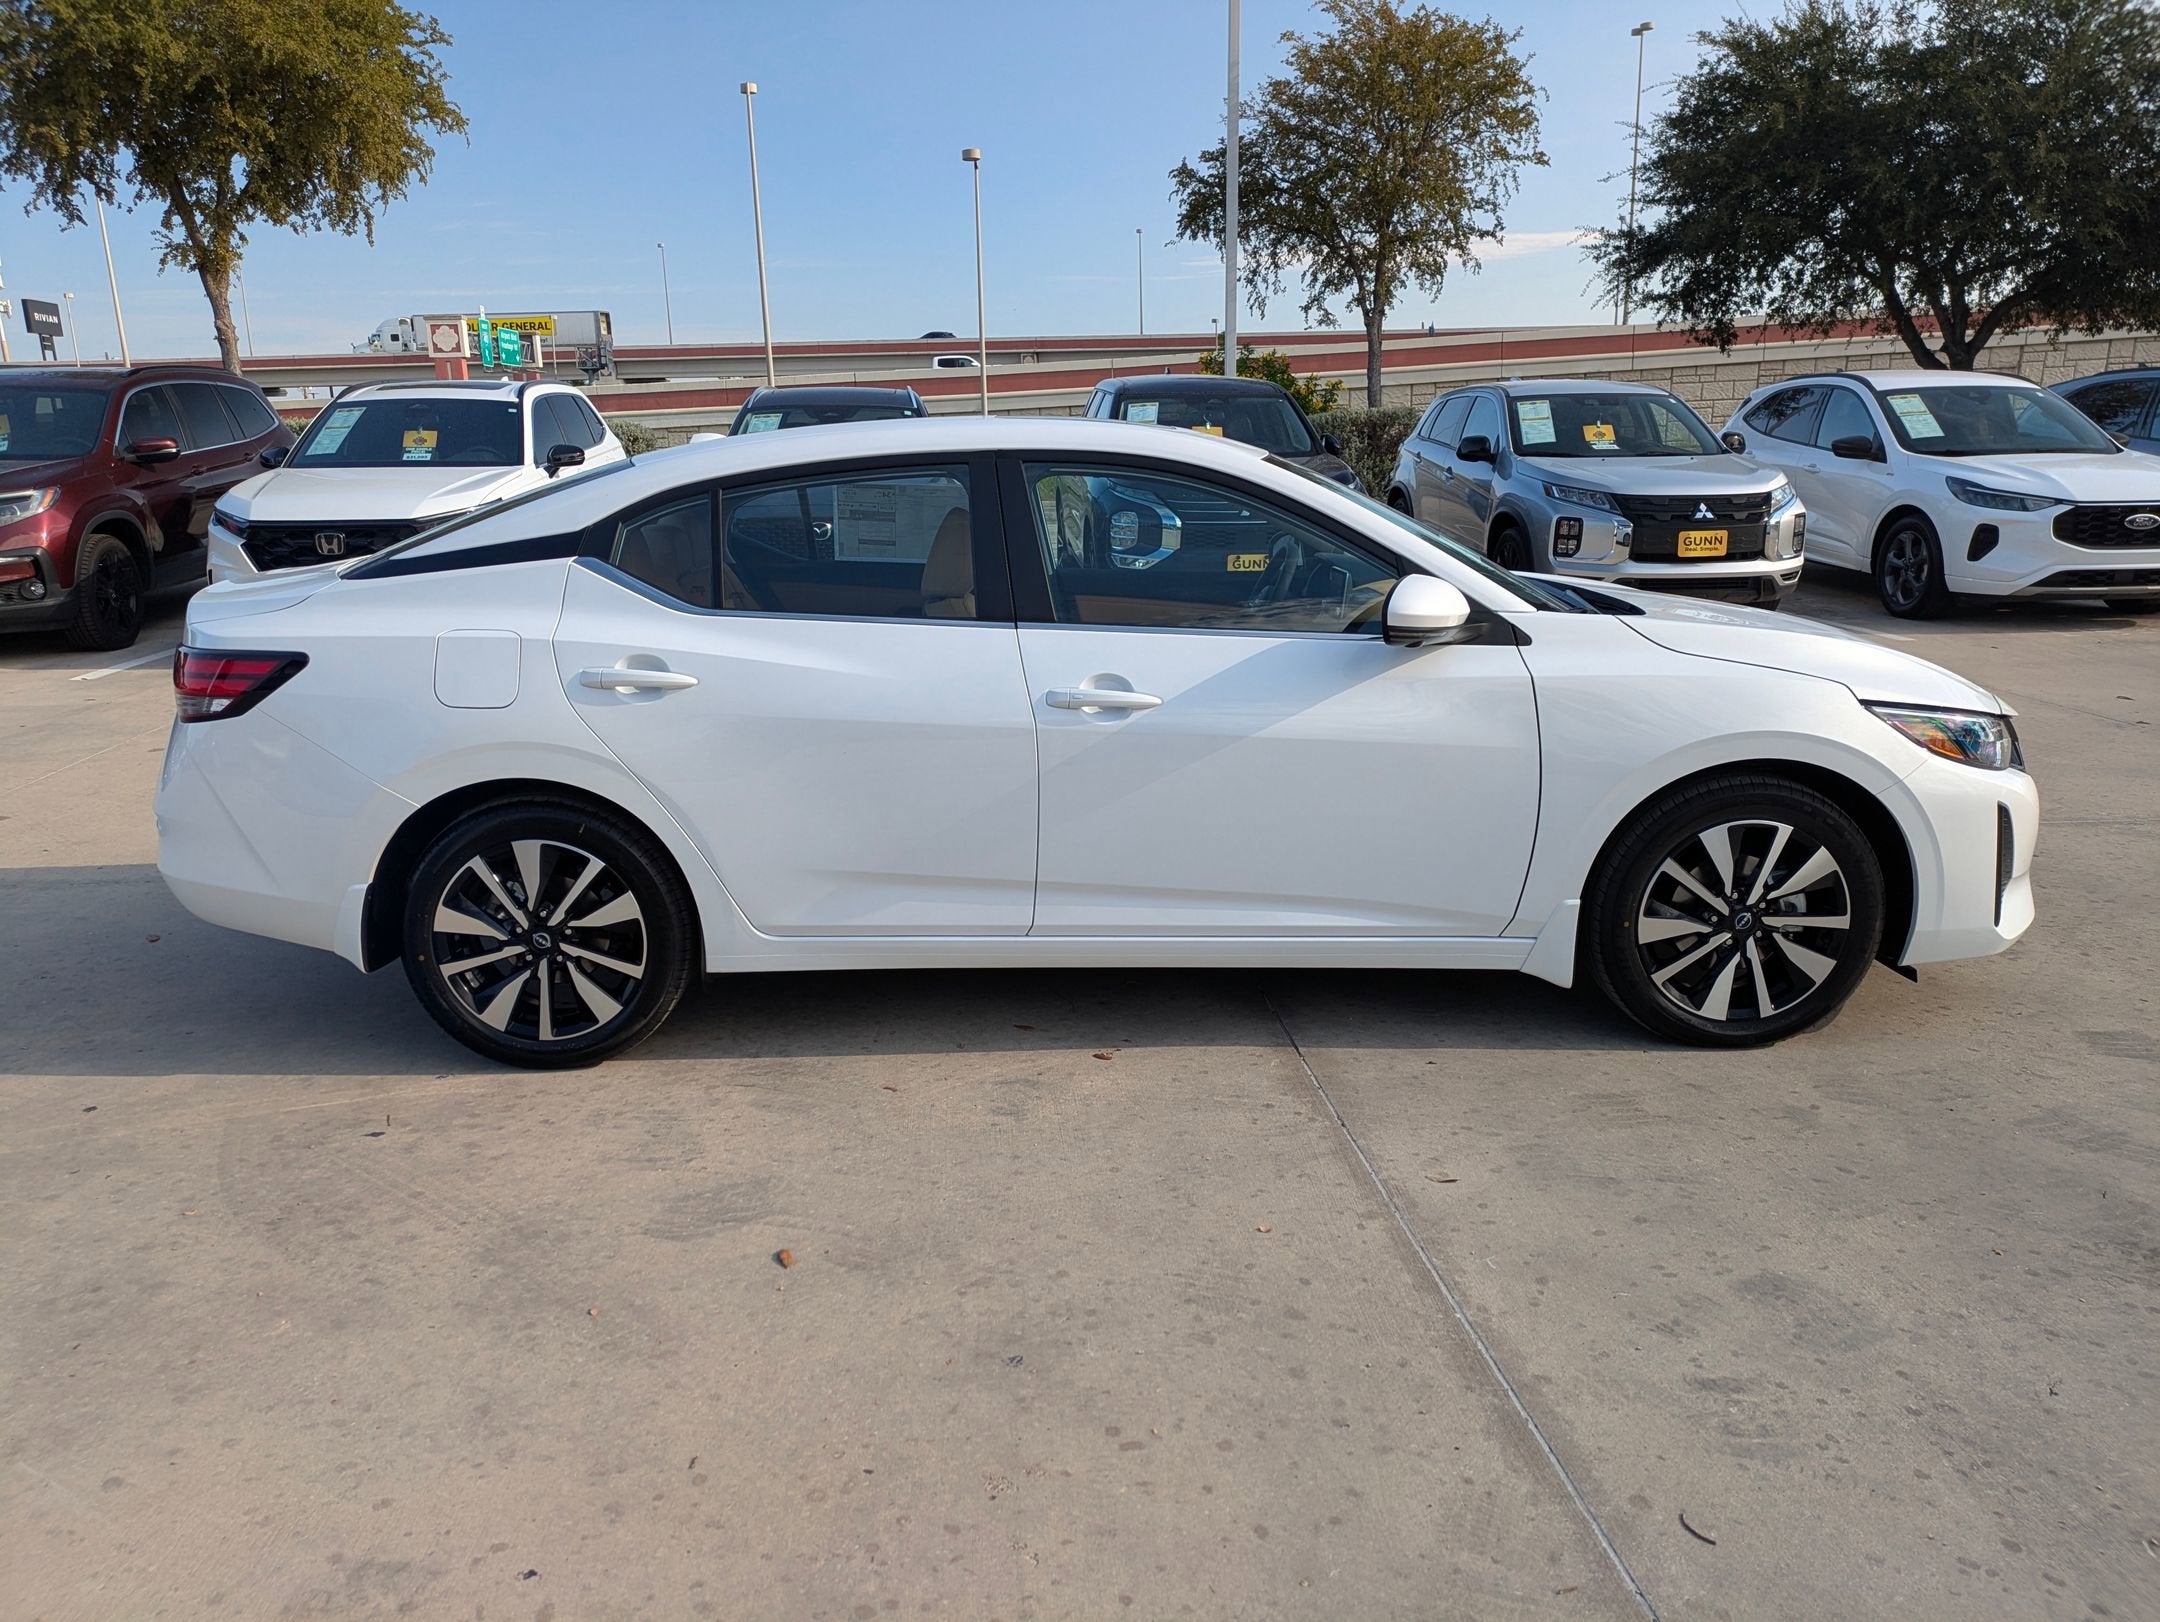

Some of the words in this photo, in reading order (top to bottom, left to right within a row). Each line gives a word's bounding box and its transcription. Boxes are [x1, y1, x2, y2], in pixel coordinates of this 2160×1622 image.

[33, 312, 59, 324] RIVIAN
[501, 321, 551, 332] GENERAL
[1683, 536, 1723, 546] GUNN
